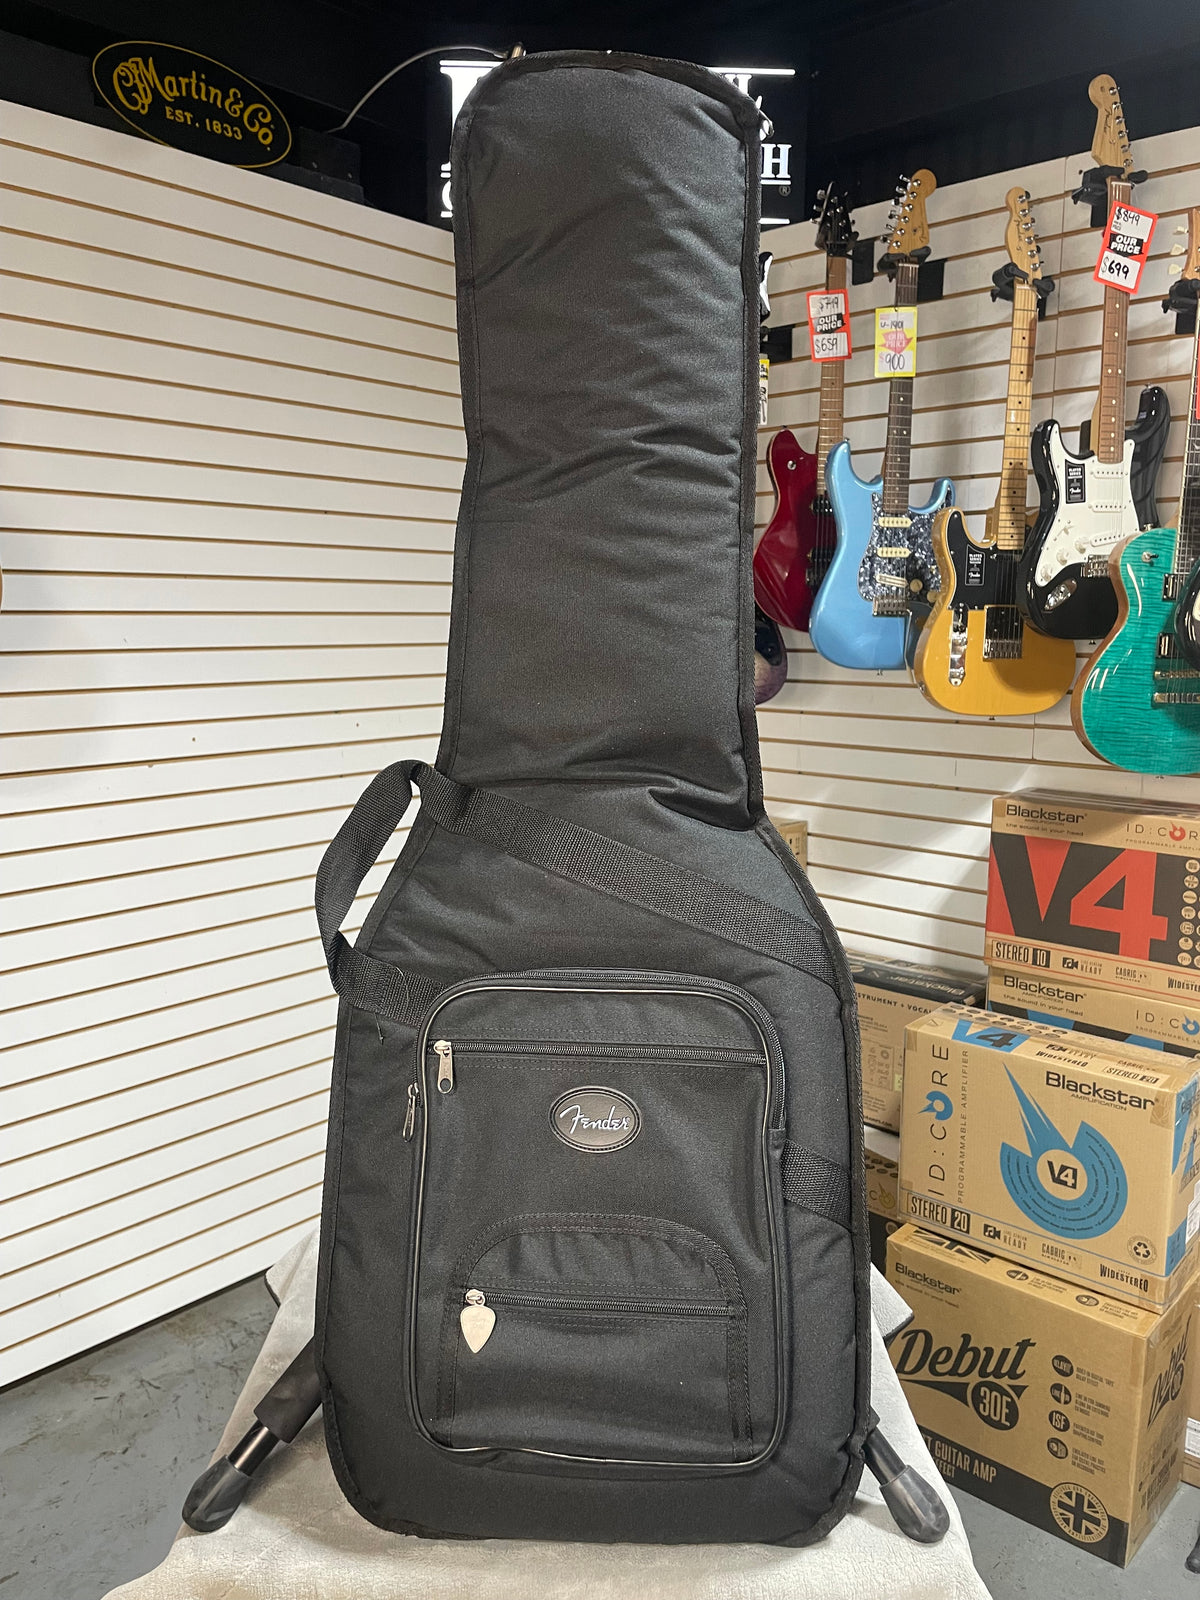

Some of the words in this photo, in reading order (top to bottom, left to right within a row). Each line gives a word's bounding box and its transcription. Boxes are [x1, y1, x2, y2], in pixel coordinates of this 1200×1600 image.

[206, 119, 243, 140] 1833
[1110, 241, 1141, 255] PRICE
[1115, 235, 1138, 246] OUR
[1101, 256, 1130, 280] $699
[816, 319, 842, 333] PRICE
[819, 314, 838, 324] OUR
[1006, 804, 1085, 824] Blackstar
[995, 942, 1030, 963] STEREO
[1036, 949, 1047, 966] 10
[1004, 974, 1084, 1003] Blackstar
[961, 1050, 969, 1108] AMPLIFIER
[1106, 1067, 1140, 1080] STEREO
[1046, 1070, 1156, 1110] Blackstar
[1071, 1093, 1127, 1111] AMPLIFICATION
[559, 1104, 630, 1134] Fender
[957, 1113, 968, 1204] PROGRAMMABLE
[1047, 1160, 1078, 1190] V4
[911, 1196, 948, 1225] STEREO
[953, 1211, 968, 1232] 20
[1003, 1236, 1027, 1251] READY
[895, 1262, 960, 1295] Blackstar
[1100, 1263, 1149, 1293] WIDESTEREO
[896, 1329, 1037, 1380] Debut
[979, 1386, 1012, 1427] 30E
[1052, 1411, 1067, 1430] ISF
[934, 1440, 971, 1473] GUITAR
[972, 1459, 997, 1483] AMP
